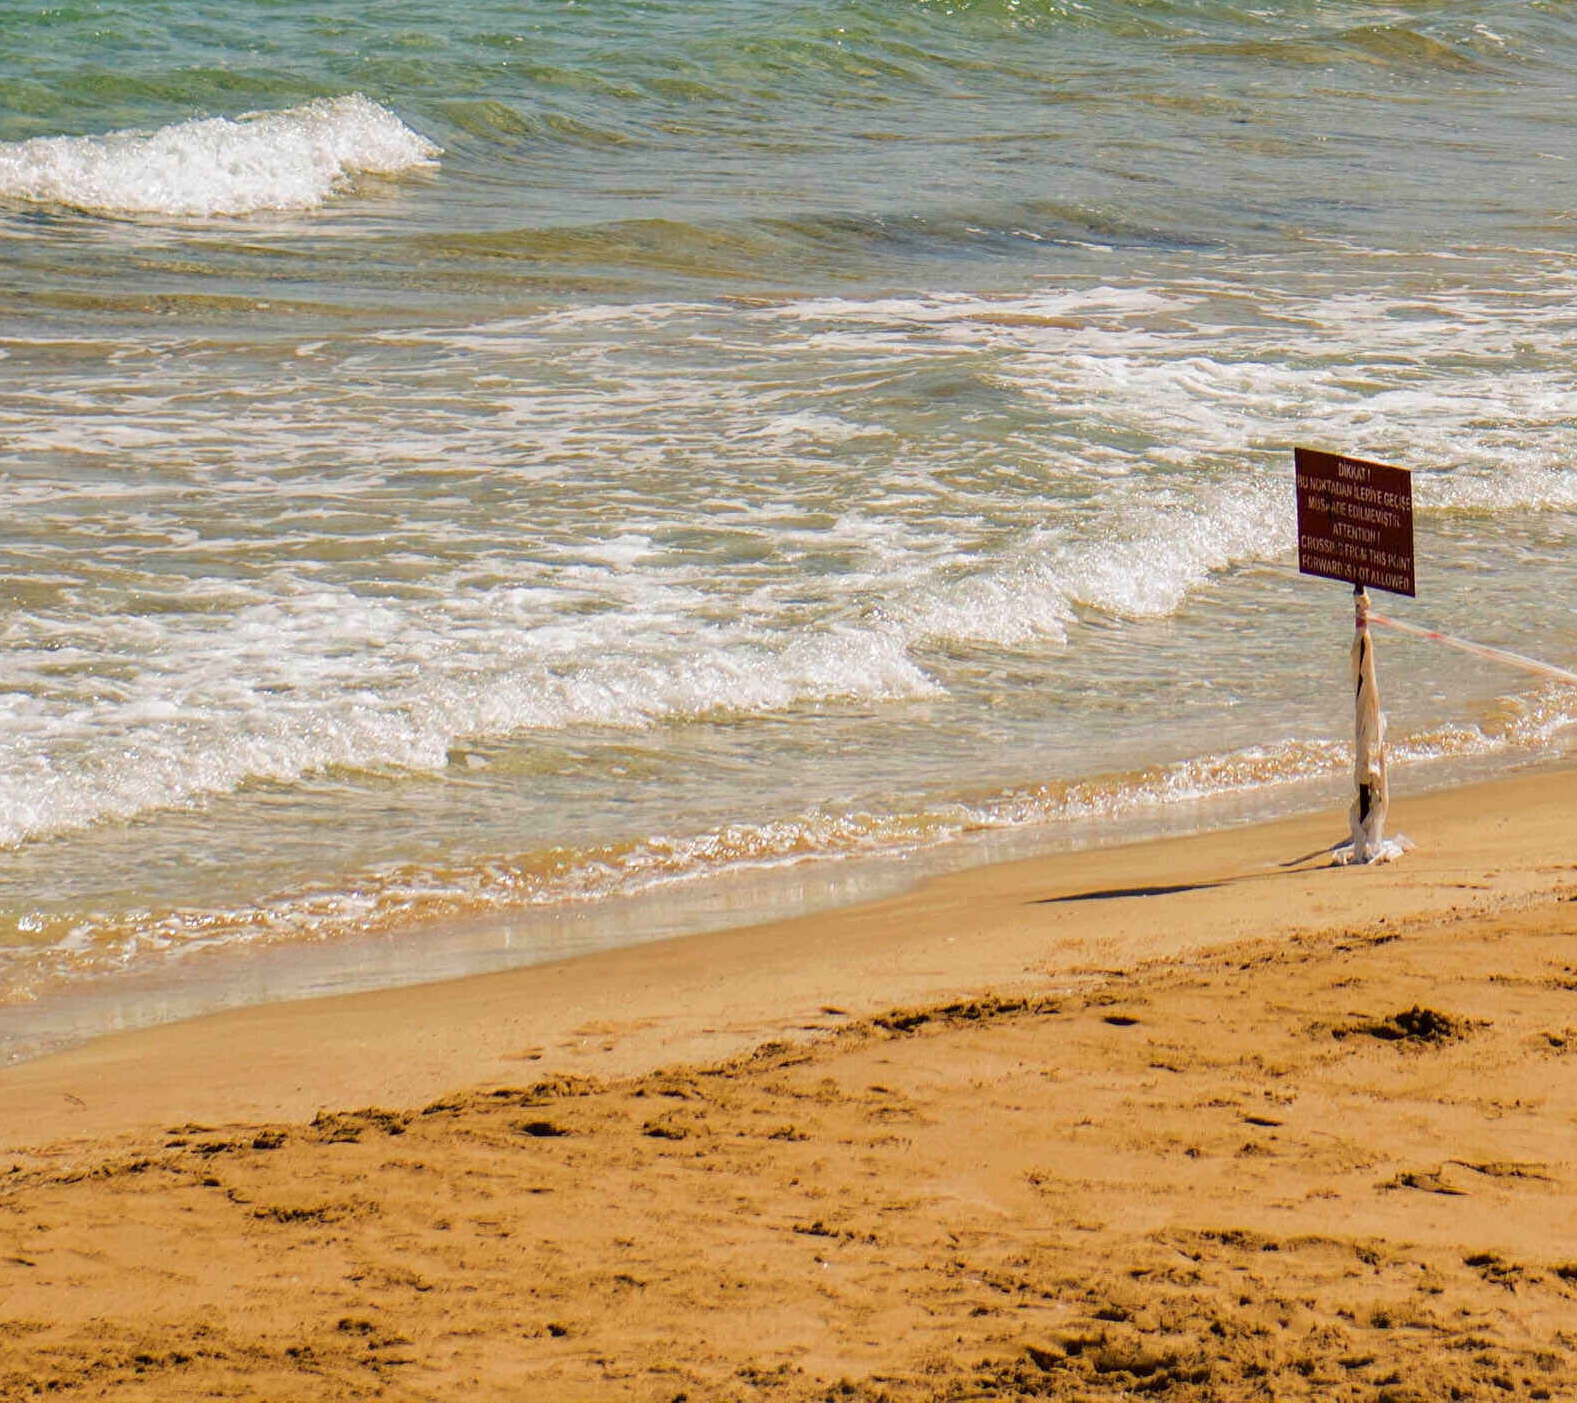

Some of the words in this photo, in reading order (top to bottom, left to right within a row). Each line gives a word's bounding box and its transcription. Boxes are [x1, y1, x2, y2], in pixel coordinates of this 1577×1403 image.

[1338, 462, 1366, 480] DİKKAT
[1298, 474, 1308, 488] BU
[1332, 523, 1376, 542] ATTENTION
[1370, 549, 1386, 566] THIS
[1302, 554, 1342, 574] FORWARD
[1372, 570, 1410, 590] ALLOWED
